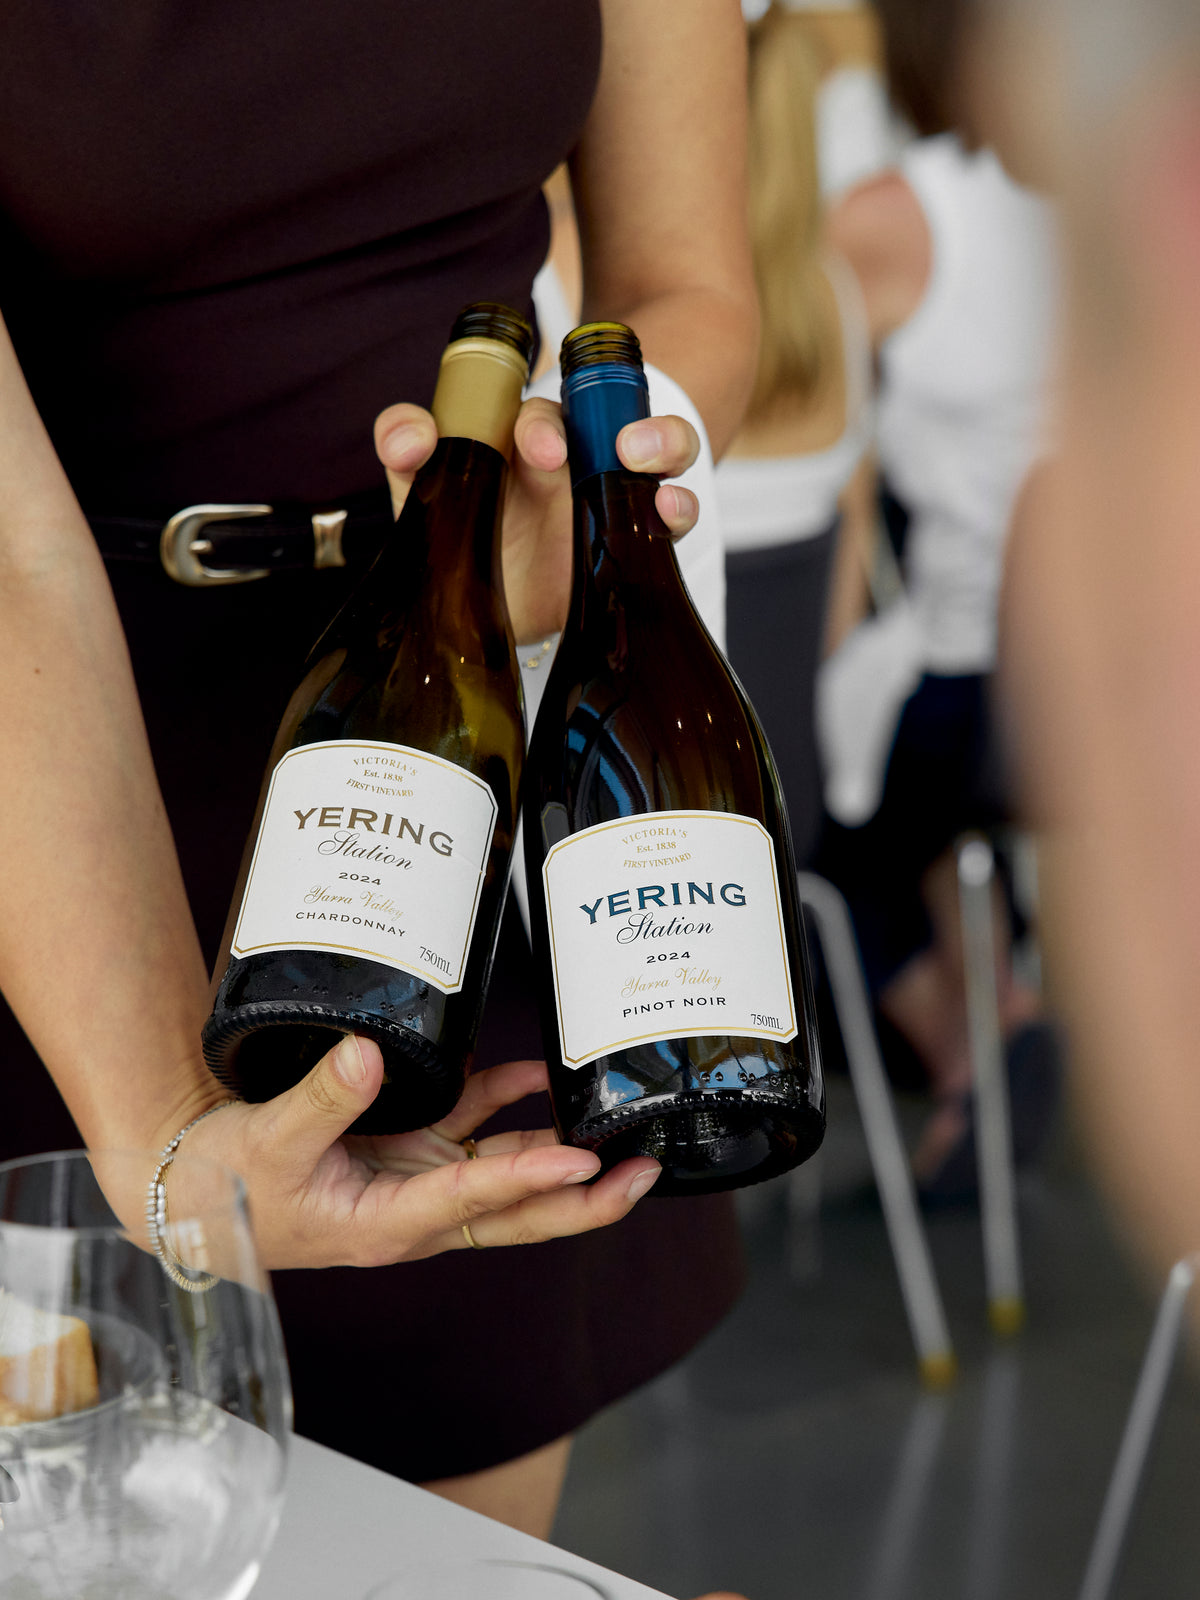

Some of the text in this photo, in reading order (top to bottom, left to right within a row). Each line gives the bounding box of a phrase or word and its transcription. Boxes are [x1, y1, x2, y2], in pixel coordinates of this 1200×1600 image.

[353, 757, 418, 776] VICTORIA'S
[363, 769, 403, 782] Est. 1838
[346, 779, 413, 797] FIRST VINEYARD
[293, 807, 454, 857] YERING
[622, 827, 688, 845] VICTORIA'S
[317, 830, 413, 870] Station
[636, 842, 677, 853] Est. 1838
[623, 852, 692, 868] FIRST VINEYARD
[338, 872, 381, 885] 2024
[303, 885, 404, 922] Yarra Valley
[579, 882, 747, 925] YERING
[295, 912, 406, 937] CHARDONNAY
[616, 912, 713, 944] Station
[419, 946, 453, 977] 750mL
[646, 951, 691, 964] 2024
[621, 967, 722, 998] Yarra Valley
[623, 997, 726, 1018] PINOT NOIR
[750, 1014, 784, 1030] 750mL
